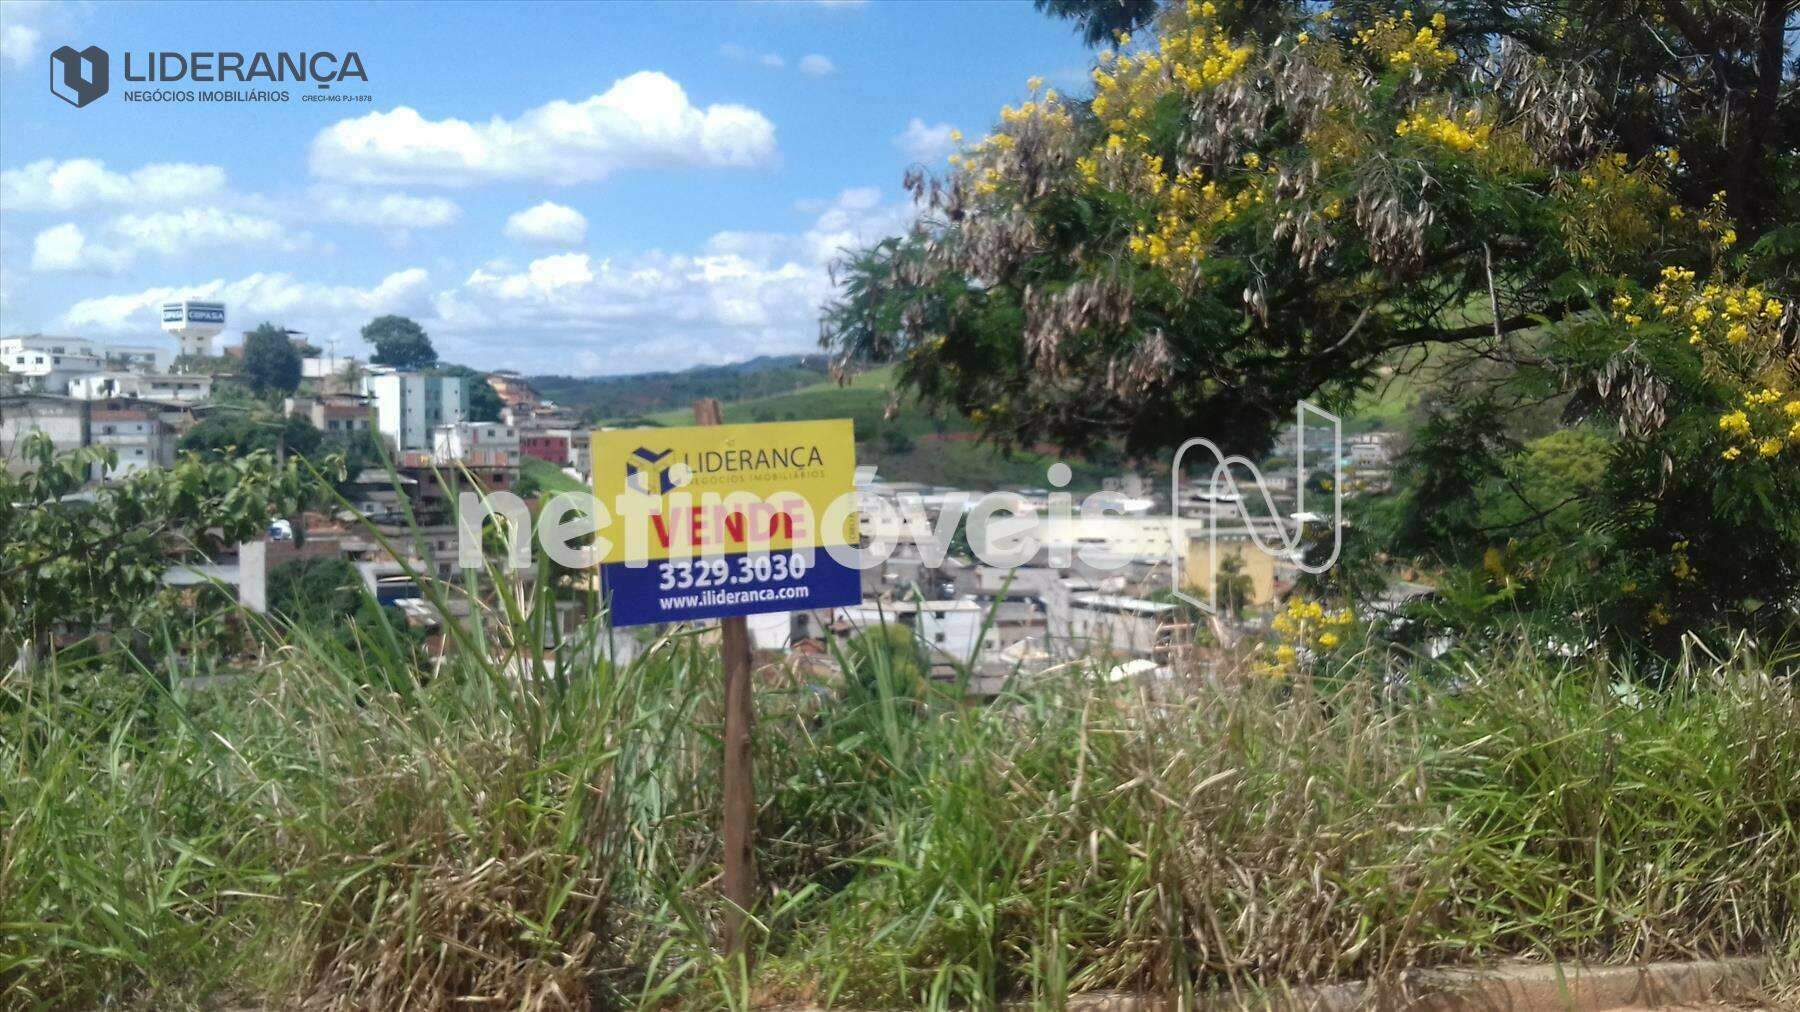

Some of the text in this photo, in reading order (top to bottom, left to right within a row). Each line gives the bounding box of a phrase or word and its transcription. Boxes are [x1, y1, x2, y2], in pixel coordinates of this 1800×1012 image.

[684, 446, 823, 474] LIDERANÇA
[648, 500, 806, 548] VENDE
[659, 553, 806, 590] 3329.3030
[660, 586, 809, 609] www.ilideranca.com
